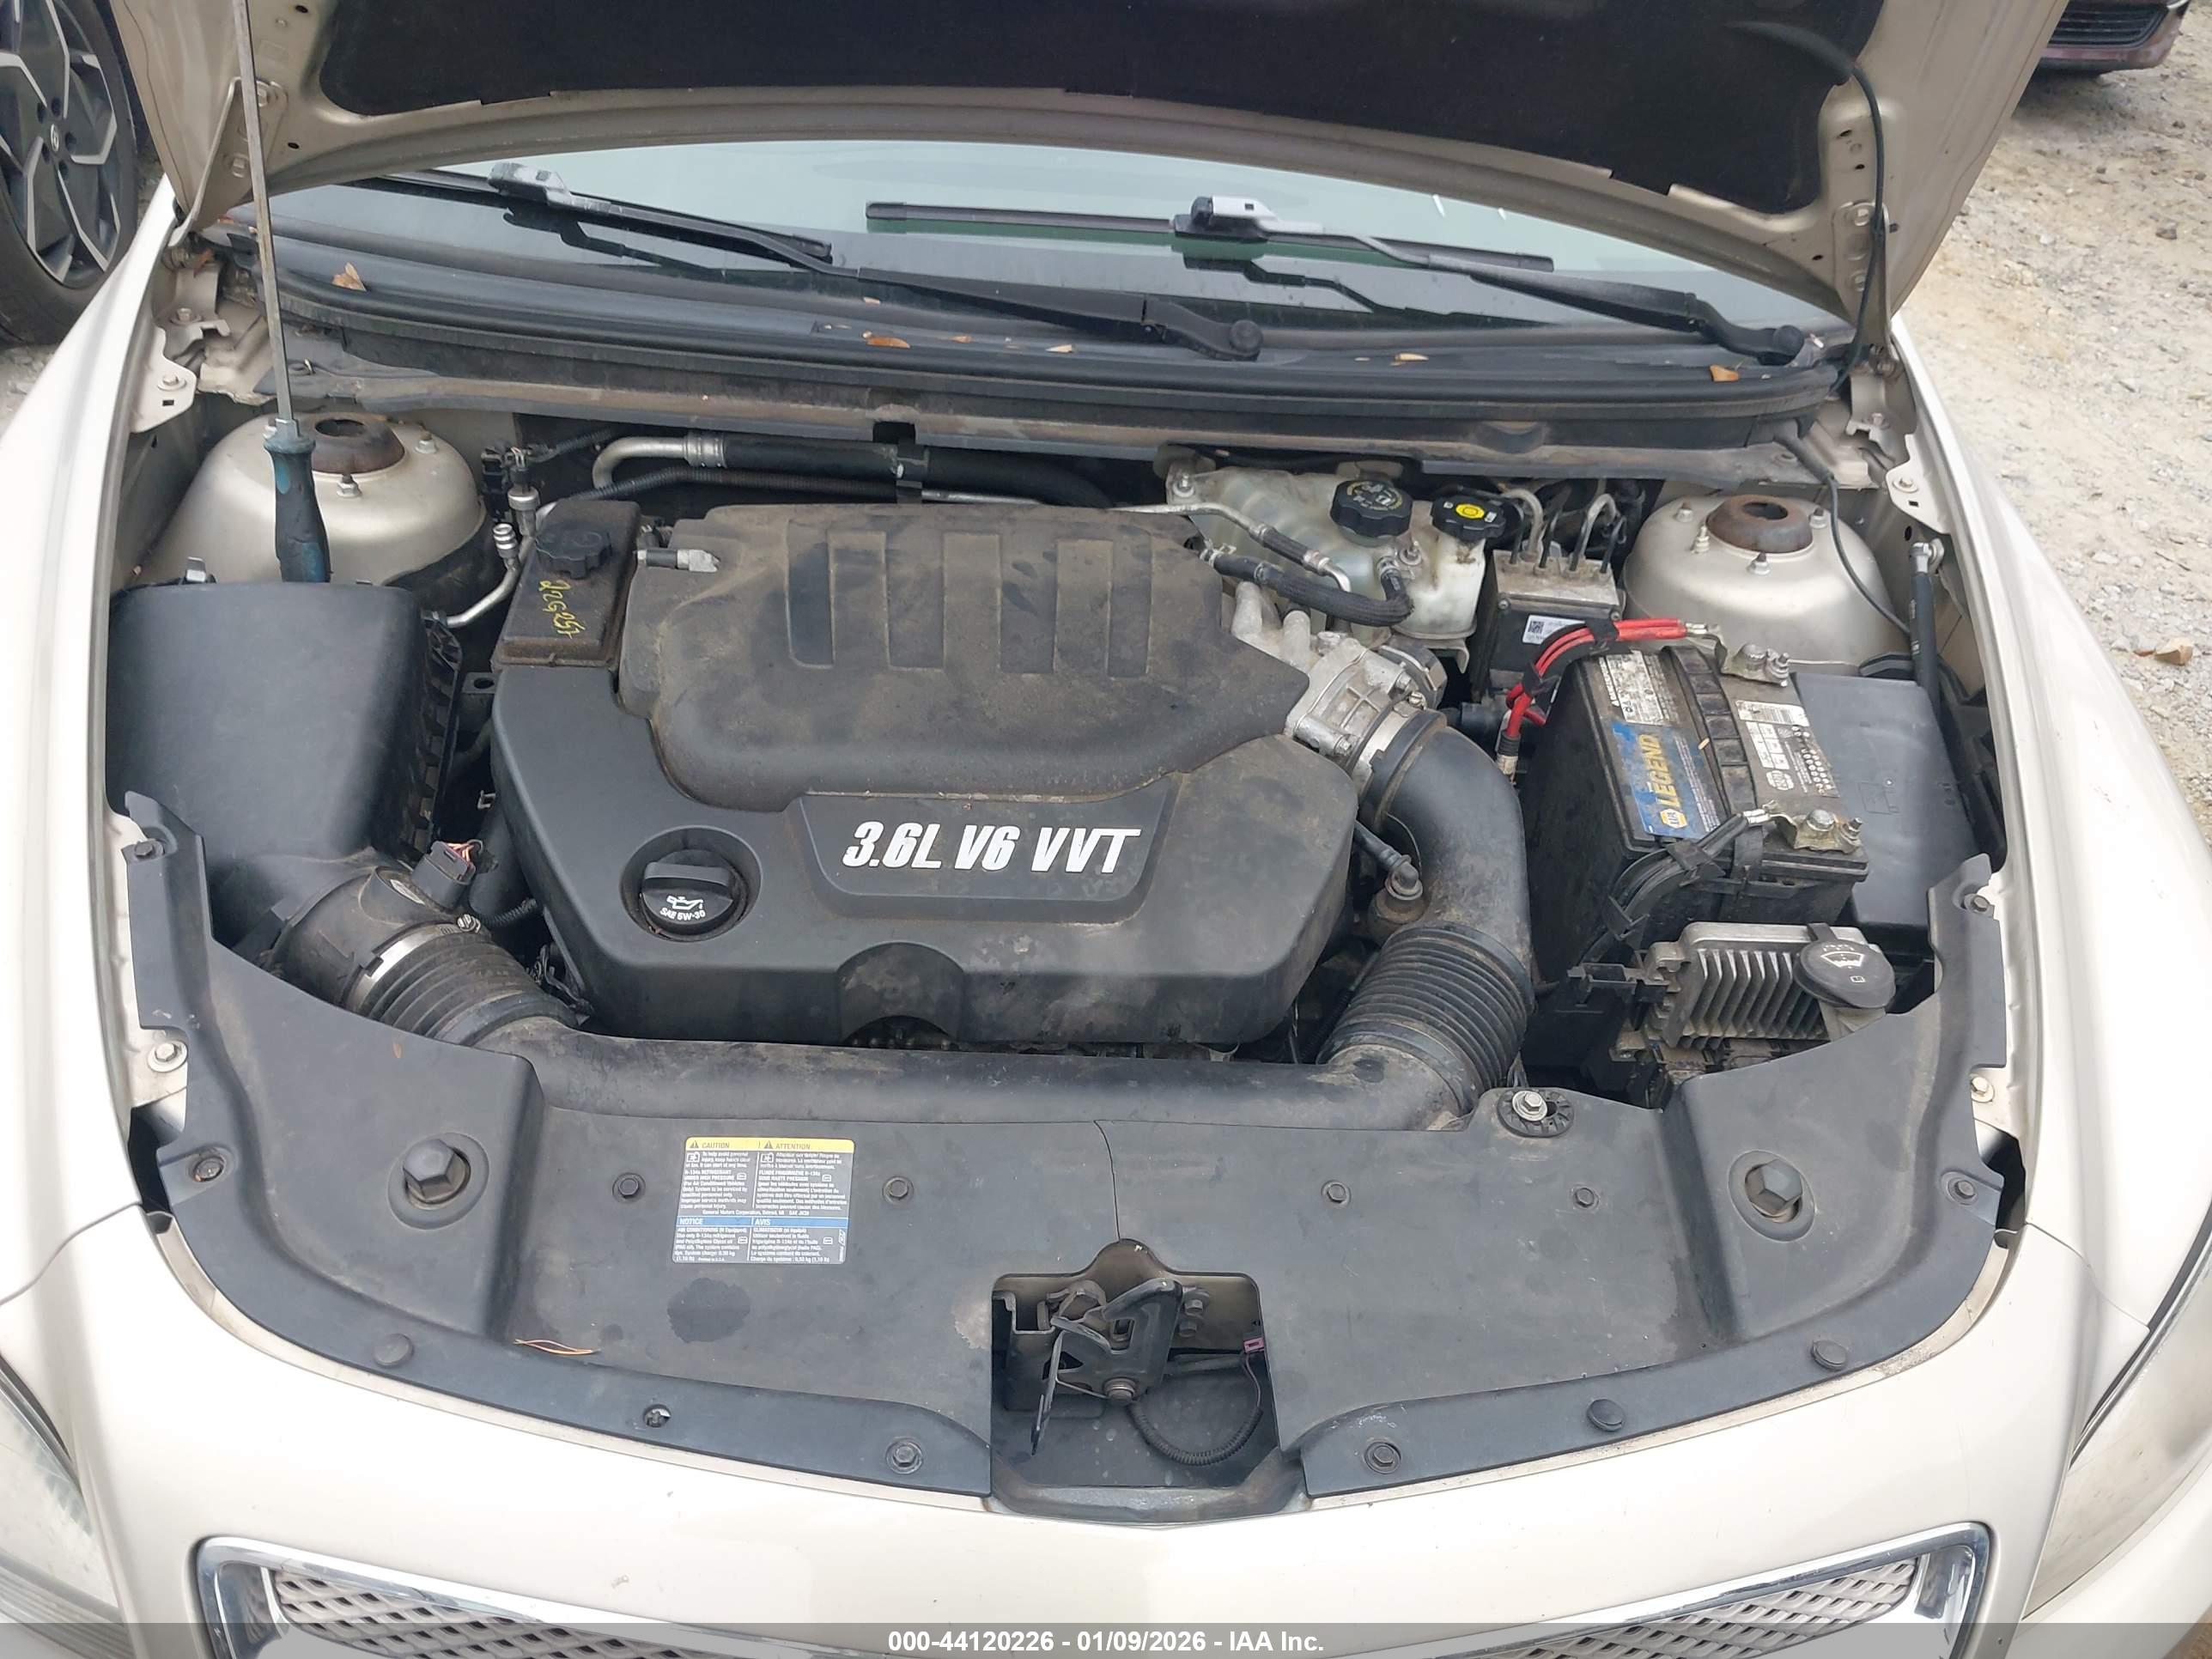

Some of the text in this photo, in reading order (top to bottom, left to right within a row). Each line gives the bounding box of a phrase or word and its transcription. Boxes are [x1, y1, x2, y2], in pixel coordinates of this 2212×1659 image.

[1638, 734, 1680, 808] LEGEND
[842, 821, 1141, 873] 3.6L V6 VVT
[660, 907, 706, 921] SAE 5W-30
